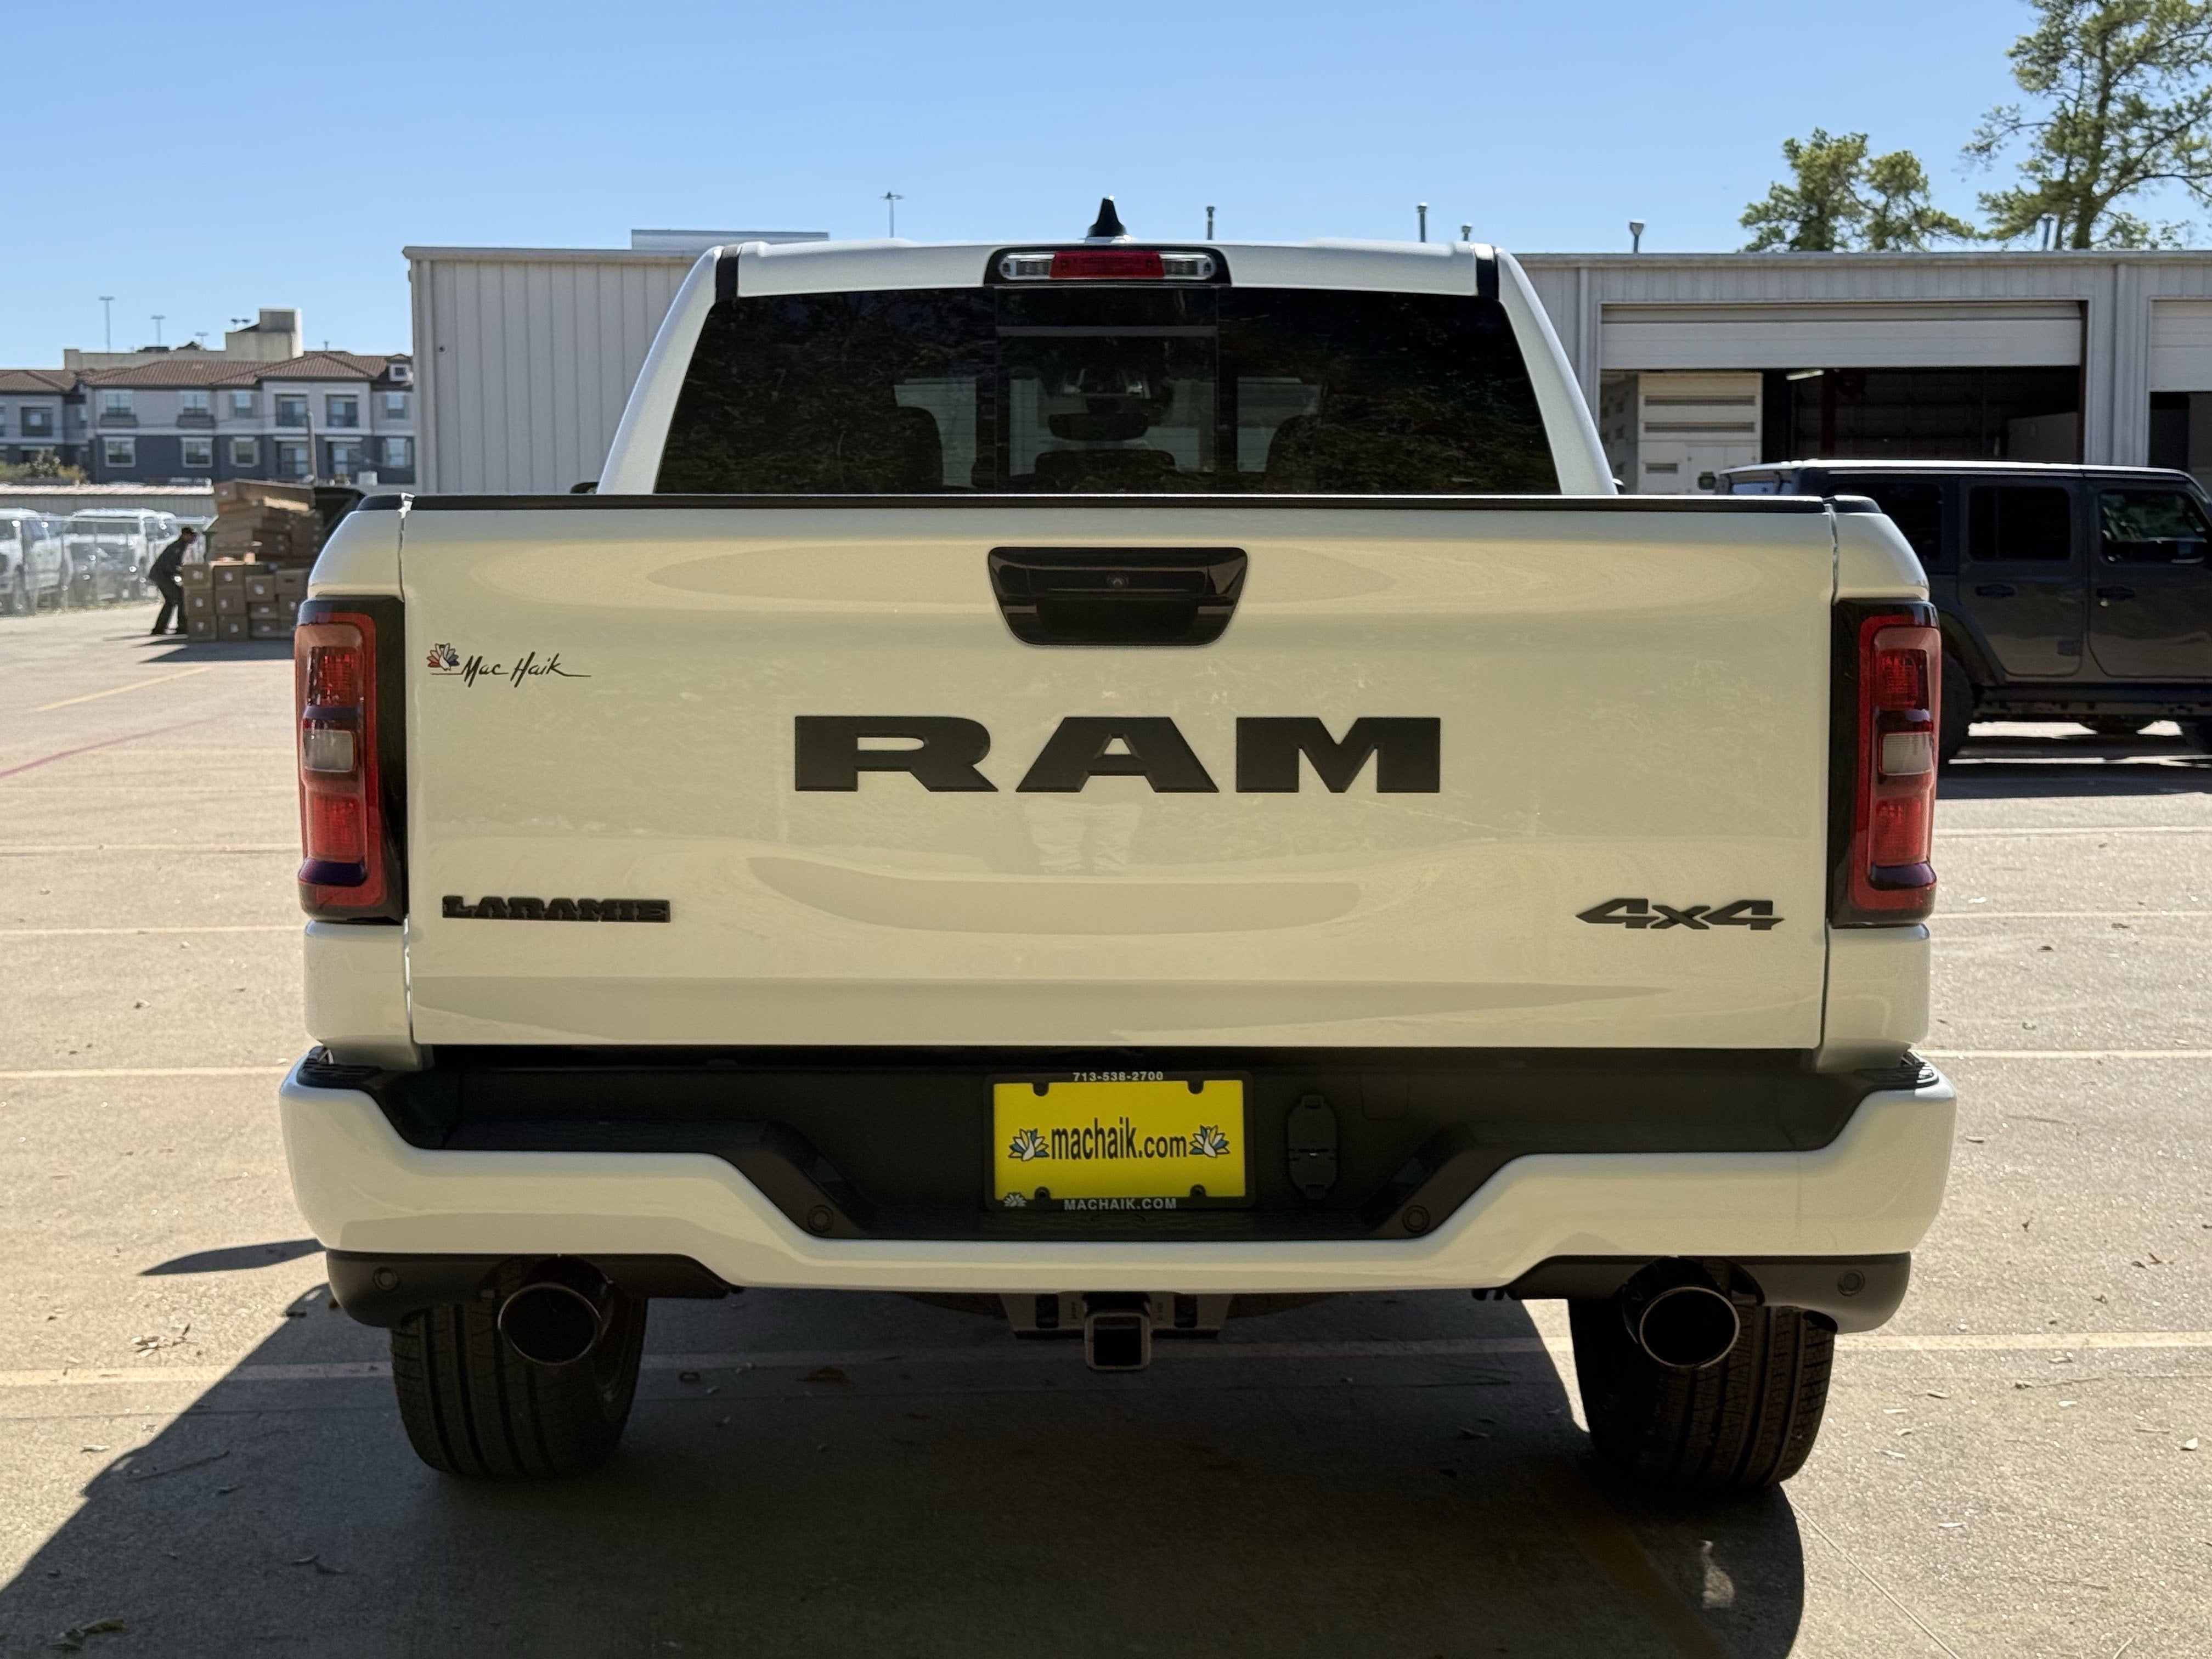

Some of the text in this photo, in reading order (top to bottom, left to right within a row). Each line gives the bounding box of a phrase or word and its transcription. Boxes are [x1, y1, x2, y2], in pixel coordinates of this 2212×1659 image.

[453, 651, 583, 688] Mac Haik
[794, 716, 1441, 793] RAM
[442, 895, 670, 923] LARAMIE
[1576, 898, 1785, 930] 4x4
[1073, 1071, 1164, 1082] 713-538-2700
[1051, 1117, 1187, 1160] machaik.com
[1064, 1198, 1177, 1210] MACHAIK.COM
